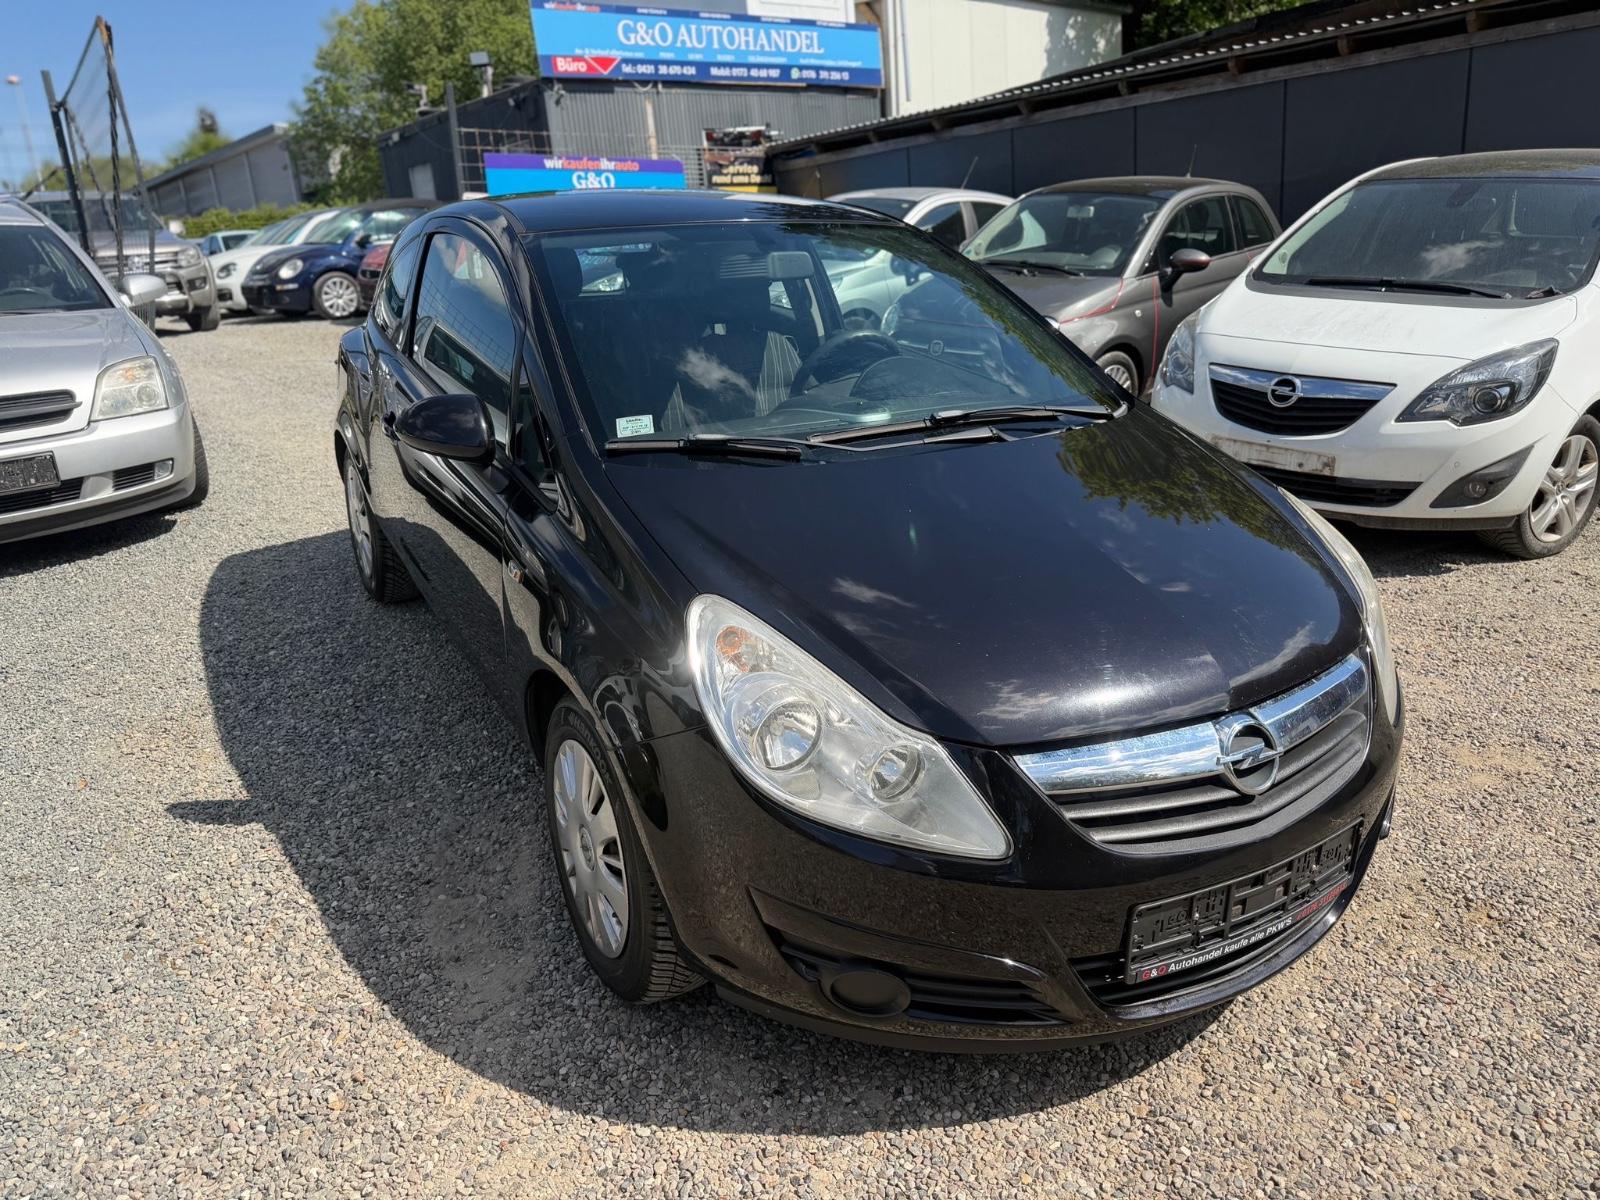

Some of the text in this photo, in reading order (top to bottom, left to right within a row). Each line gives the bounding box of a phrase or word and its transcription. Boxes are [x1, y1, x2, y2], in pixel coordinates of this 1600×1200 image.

[617, 19, 824, 54] G&O AUTOHANDEL
[556, 57, 587, 72] Büro
[543, 156, 640, 172] wirkaufenihrauto
[572, 171, 616, 189] G&O
[1142, 964, 1168, 981] G&O
[1168, 946, 1223, 973] Autohandel
[1224, 938, 1248, 954] kaufe
[1249, 931, 1265, 945] alle
